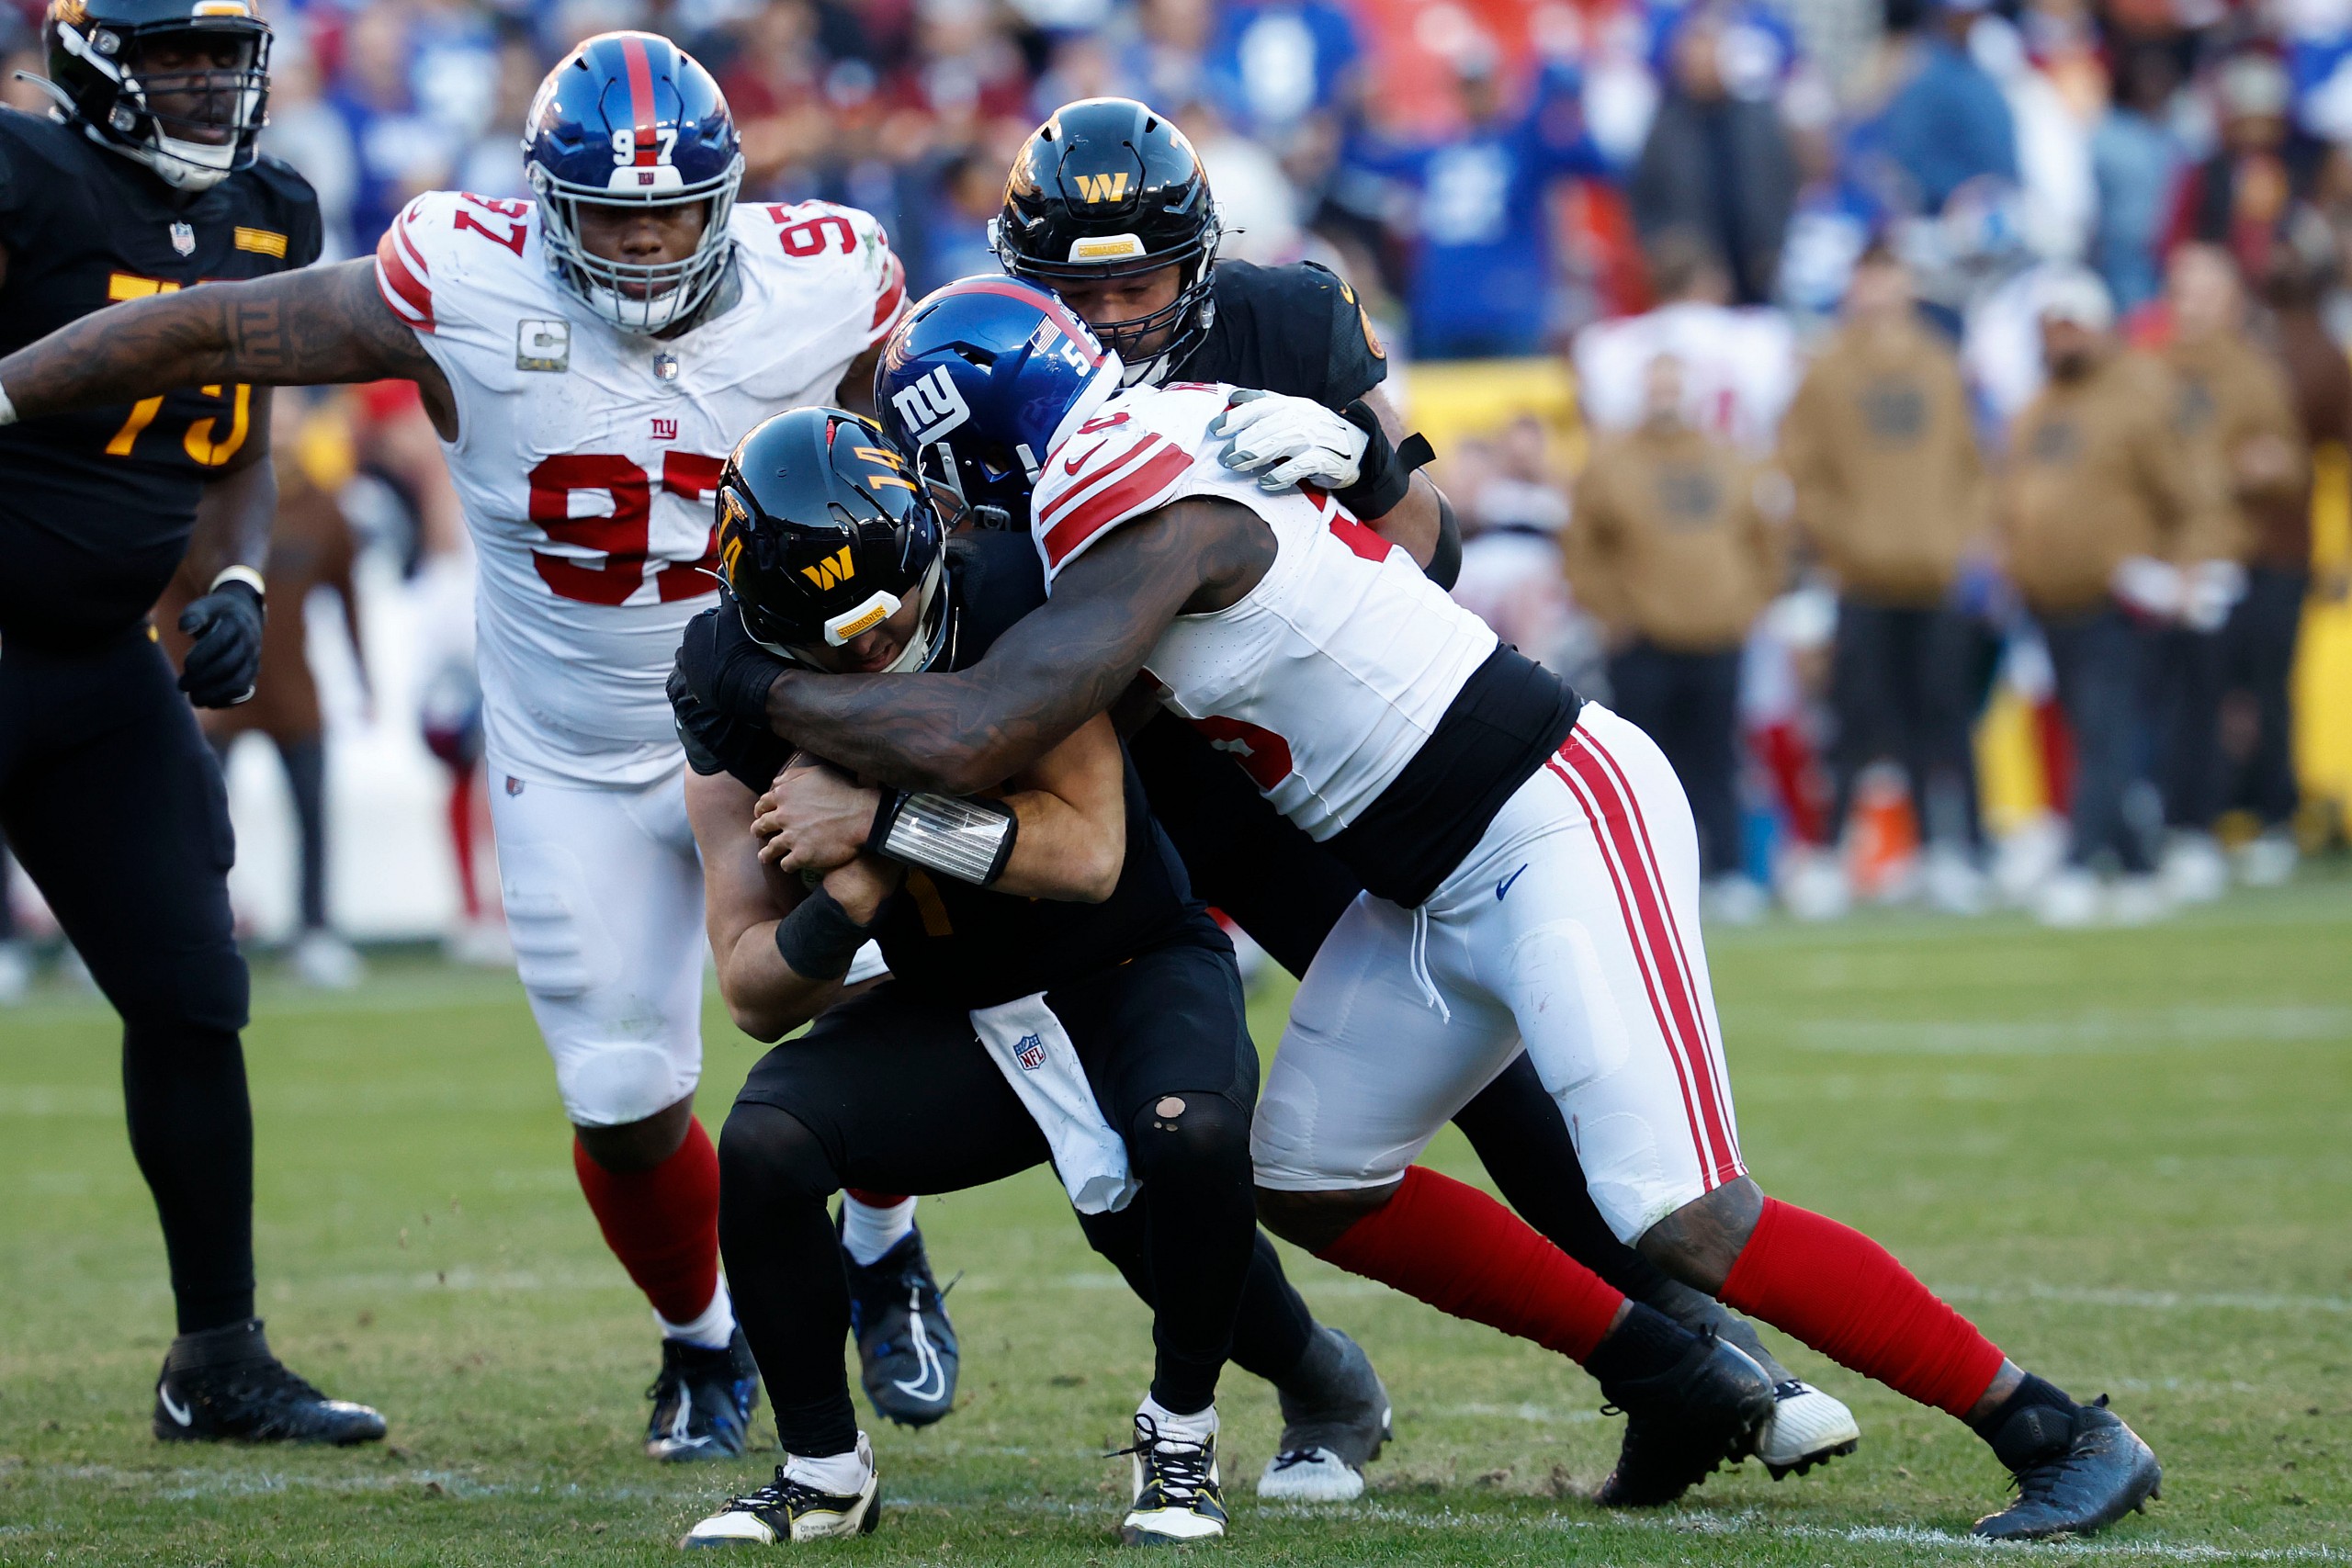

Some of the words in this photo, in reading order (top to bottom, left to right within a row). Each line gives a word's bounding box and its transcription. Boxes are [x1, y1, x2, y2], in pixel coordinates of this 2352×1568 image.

[612, 129, 678, 166] 97
[1073, 172, 1129, 204] W
[1078, 242, 1134, 256] COMMANDERS
[519, 321, 568, 360] C
[1060, 322, 1102, 377] 55
[891, 364, 970, 446] ny
[854, 446, 919, 492] 14
[800, 545, 855, 592] W
[836, 604, 888, 639] COMMANDERS
[1019, 1046, 1045, 1068] NFL
